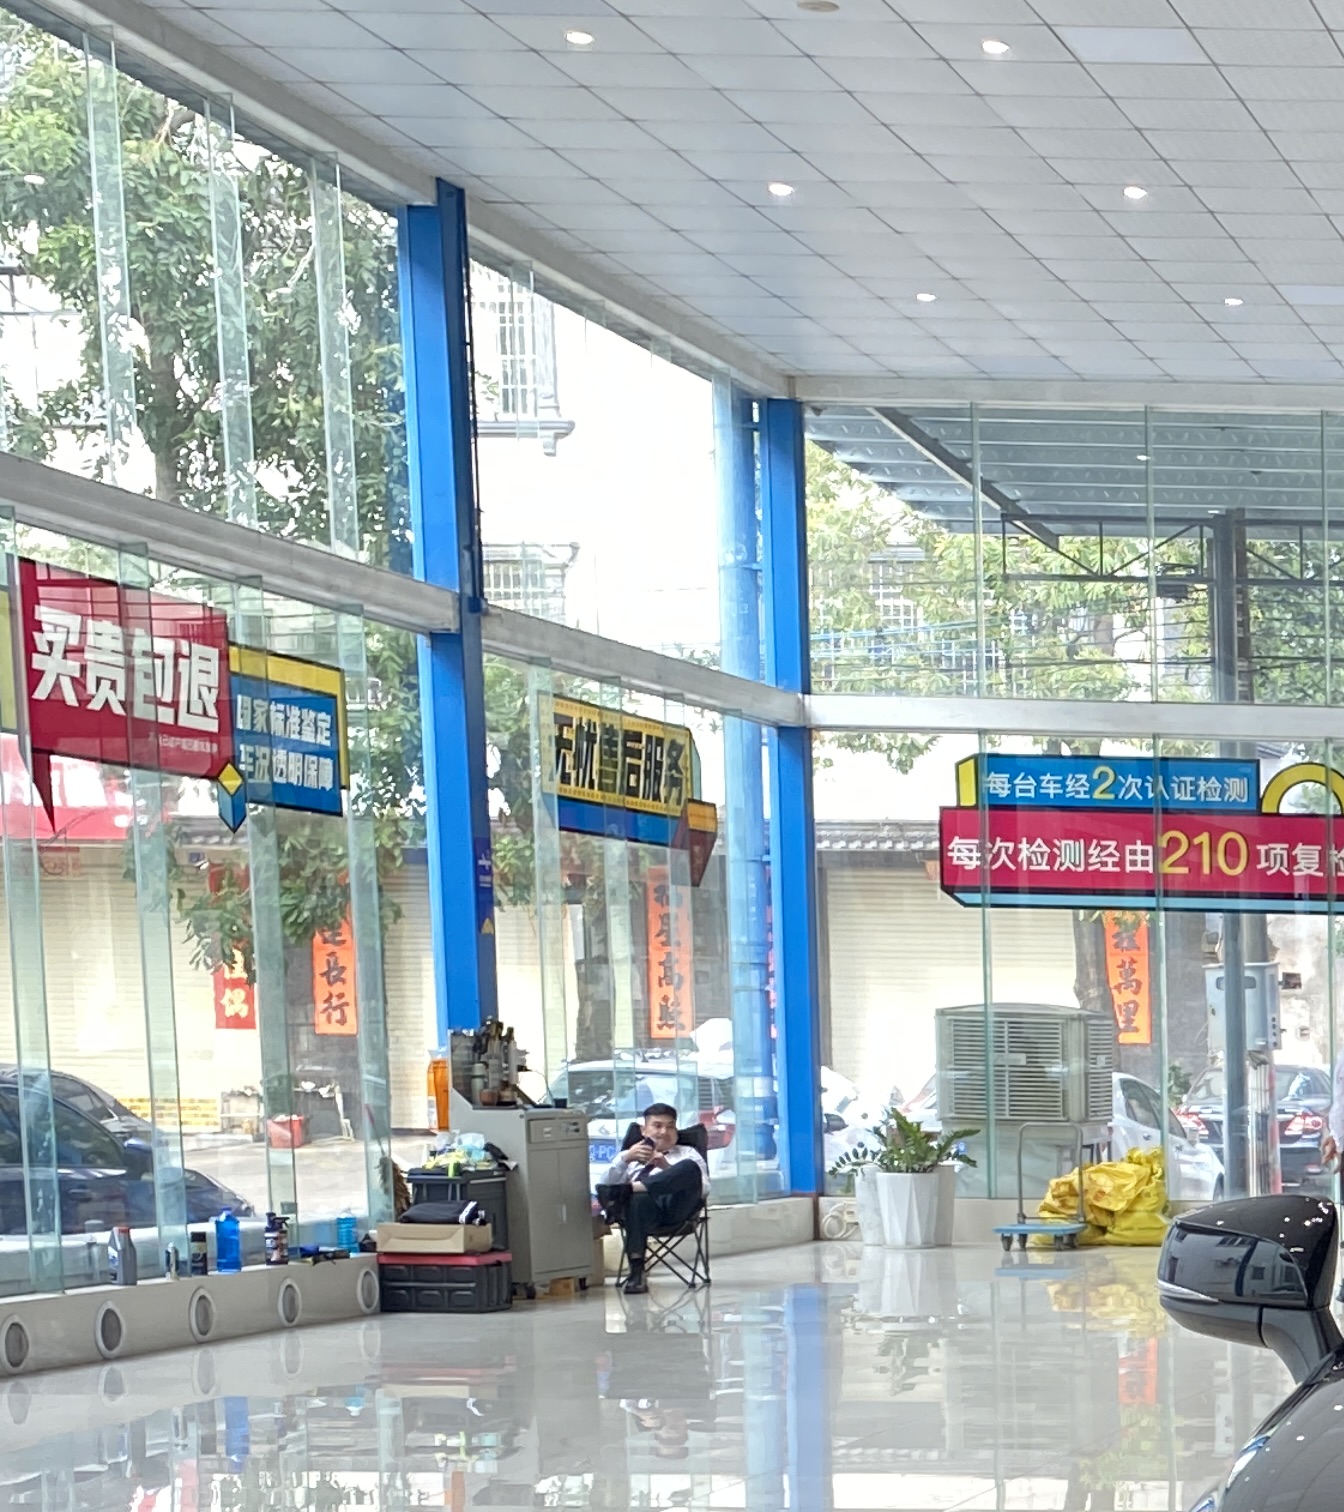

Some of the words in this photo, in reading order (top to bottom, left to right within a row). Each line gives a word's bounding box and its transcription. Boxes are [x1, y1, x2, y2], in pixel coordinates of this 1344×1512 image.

[987, 764, 1248, 803] 每台车经2次认证检测
